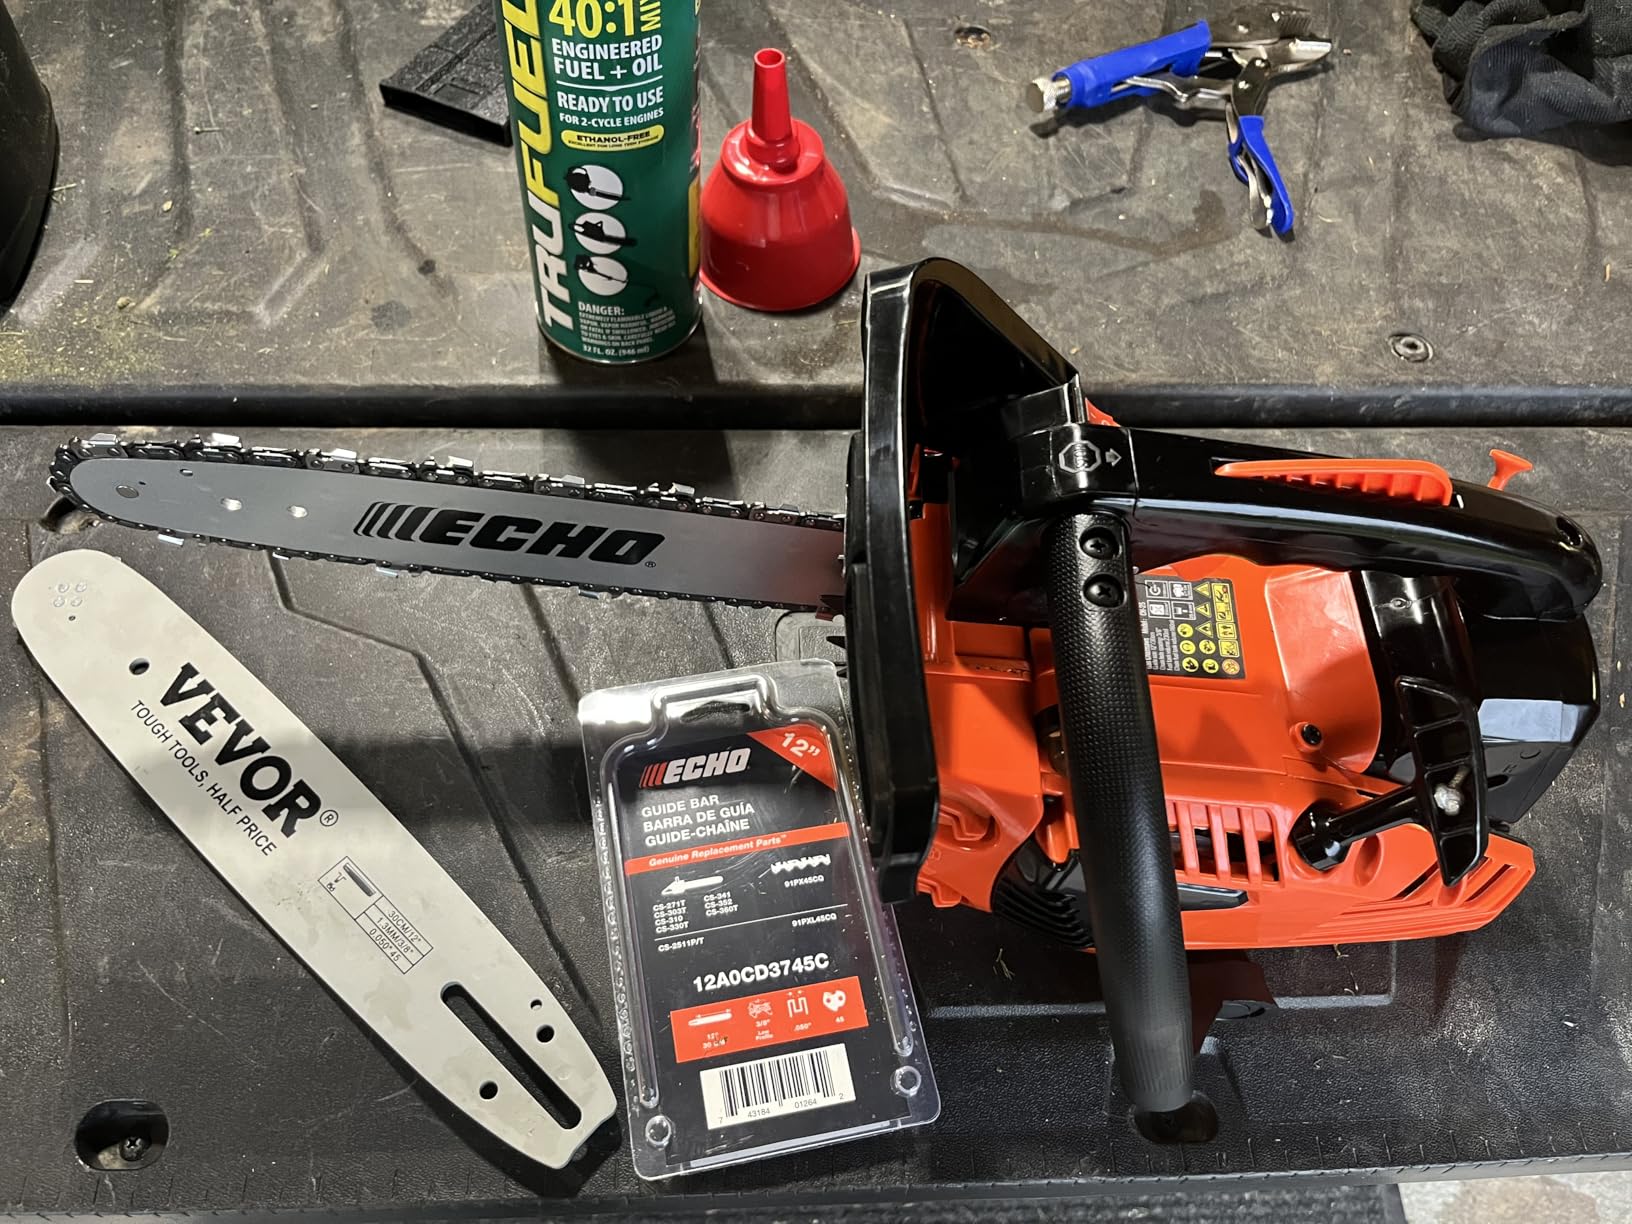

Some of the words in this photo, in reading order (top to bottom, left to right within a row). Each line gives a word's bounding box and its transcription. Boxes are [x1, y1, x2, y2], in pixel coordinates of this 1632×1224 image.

[549, 0, 635, 38] 40:1
[640, 0, 661, 32] MI
[552, 34, 663, 61] ENGINEERED
[553, 57, 605, 80] FUEL
[632, 53, 663, 76] OIL
[557, 91, 610, 113] READY
[612, 95, 634, 113] TO
[637, 86, 664, 109] USE
[559, 112, 580, 125] FOR
[581, 118, 622, 127] 2-CYCLE
[624, 107, 664, 126] ENGINES
[576, 131, 651, 144] ETHANOL-FREE
[578, 301, 625, 316] DANGER:
[583, 344, 592, 353] 32
[593, 346, 604, 355] FL.
[604, 348, 618, 356] OZ.
[418, 509, 666, 566] ECHO
[160, 662, 321, 838] VEVOR
[780, 732, 821, 757] 12"
[131, 700, 174, 744] TOUGH
[168, 739, 209, 788] TOOLS,
[206, 782, 243, 816] HALF
[237, 815, 278, 856] PRICE
[663, 747, 752, 785] ECHO
[641, 802, 687, 818] GUIDE
[690, 794, 720, 809] BAR
[643, 815, 693, 833] BARRA
[696, 809, 717, 823] DE
[719, 801, 755, 819] GUÍA
[644, 818, 751, 848] GUIDE-CHAÎNE
[649, 853, 689, 867] Genuine
[691, 840, 755, 860] Replacement
[652, 900, 686, 912] CS-271T
[703, 892, 731, 902] CS-341
[704, 899, 733, 910] CS-352
[388, 910, 422, 943] 30CM/12"
[653, 907, 688, 919] CS-303T
[654, 915, 684, 927] CS-310
[376, 917, 415, 954] 1.3MM/3/8"
[655, 921, 690, 934] CS-330T
[390, 949, 401, 962] 45
[658, 937, 705, 953] CS-2511P/T
[692, 952, 830, 993] 12A0CD3745C
[718, 1116, 724, 1124] 7
[747, 1107, 772, 1118] 43184
[794, 1098, 818, 1109] 01264
[839, 1092, 845, 1100] 2
